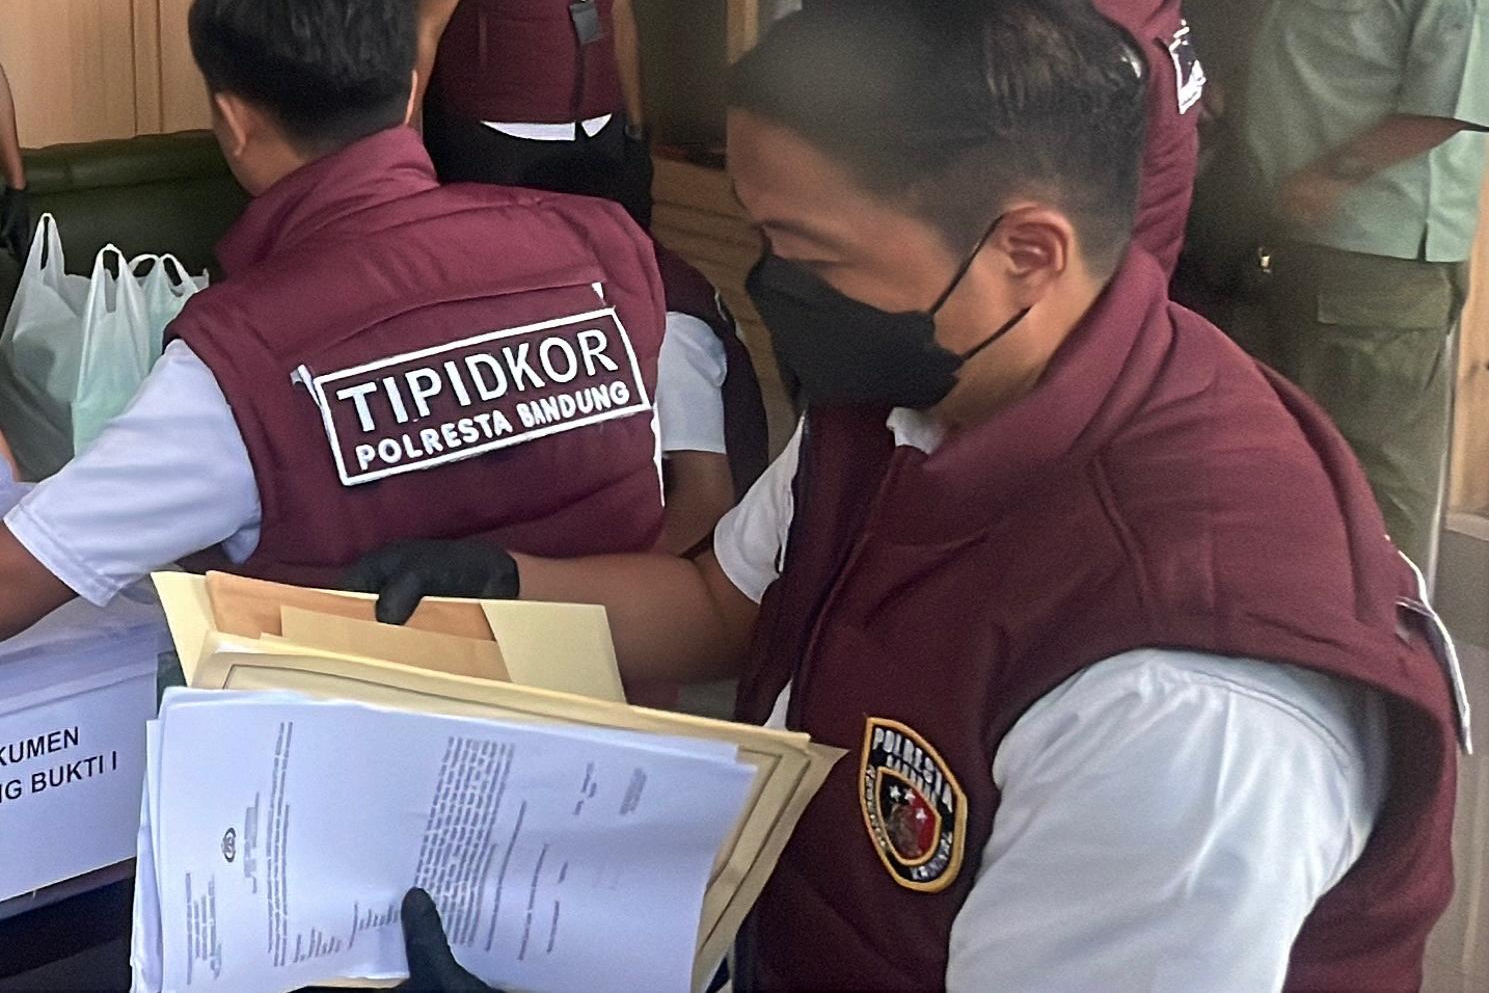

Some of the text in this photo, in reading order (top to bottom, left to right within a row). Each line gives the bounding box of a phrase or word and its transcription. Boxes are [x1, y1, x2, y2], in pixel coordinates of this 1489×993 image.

[337, 329, 619, 432] TIPIDKOR
[355, 380, 630, 471] POLRESTA BANDUNG
[31, 754, 104, 793] BUKTI
